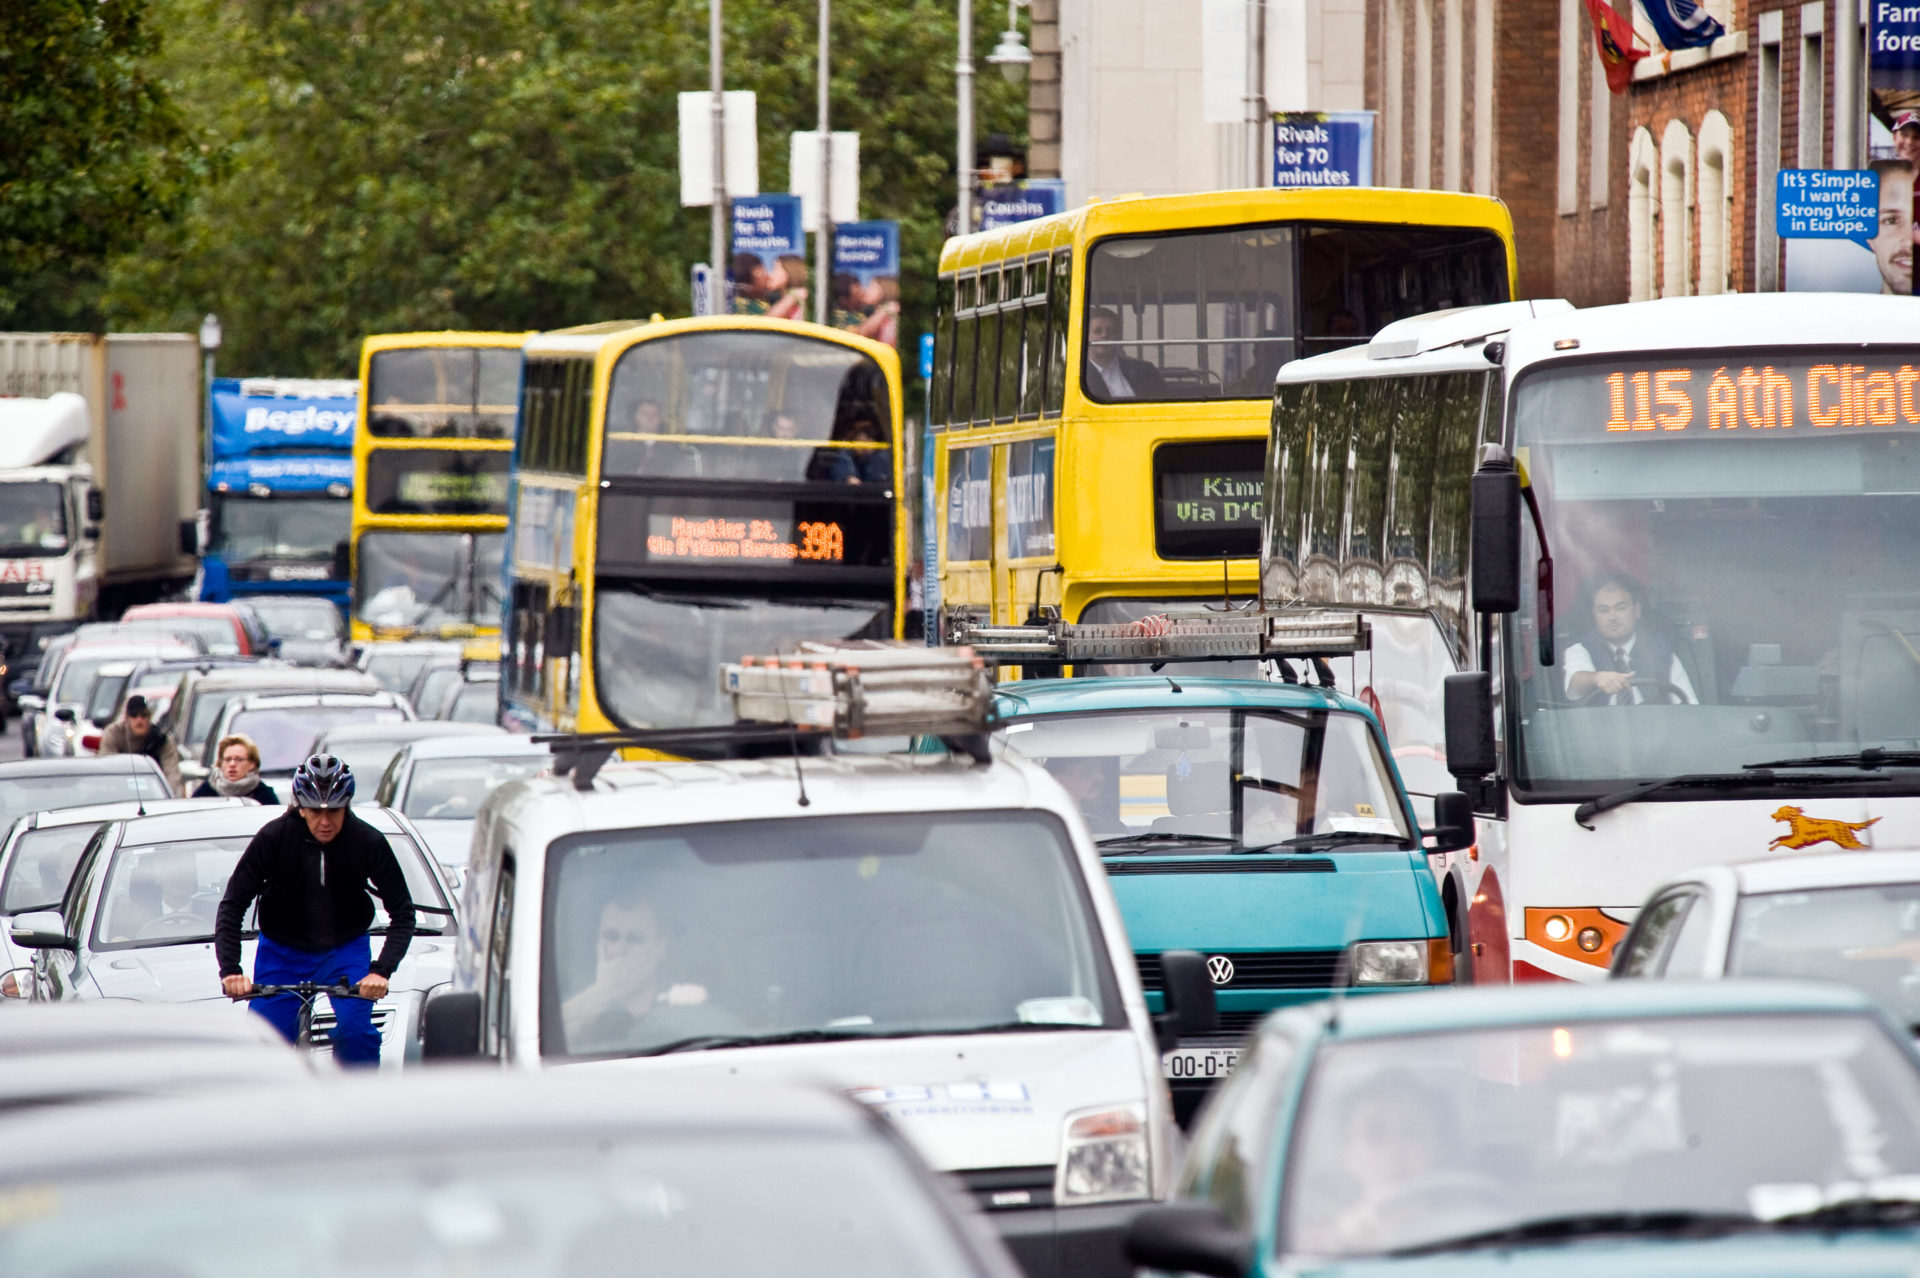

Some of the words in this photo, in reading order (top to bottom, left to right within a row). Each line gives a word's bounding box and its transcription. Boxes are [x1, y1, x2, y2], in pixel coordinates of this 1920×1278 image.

[1878, 2, 1920, 23] Fam
[1877, 29, 1920, 52] fore
[1277, 125, 1329, 143] Rivals
[1277, 146, 1304, 165] for
[1306, 147, 1329, 165] 70
[1277, 166, 1351, 185] minutes
[1783, 172, 1807, 188] It's
[1811, 172, 1876, 192] Simple.
[1801, 189, 1806, 202] I
[1810, 190, 1847, 203] want
[1850, 192, 1860, 203] a
[983, 199, 1045, 217] Cousins
[1782, 203, 1833, 220] Strong
[1836, 203, 1877, 218] Voice
[1791, 217, 1806, 231] in
[1809, 218, 1868, 235] Europe.
[1605, 368, 1694, 432] 115
[1708, 366, 1794, 430] Áth
[1807, 363, 1920, 428] Cliat
[244, 405, 356, 436] Begley
[1177, 502, 1215, 522] Via
[799, 521, 844, 560] 39A
